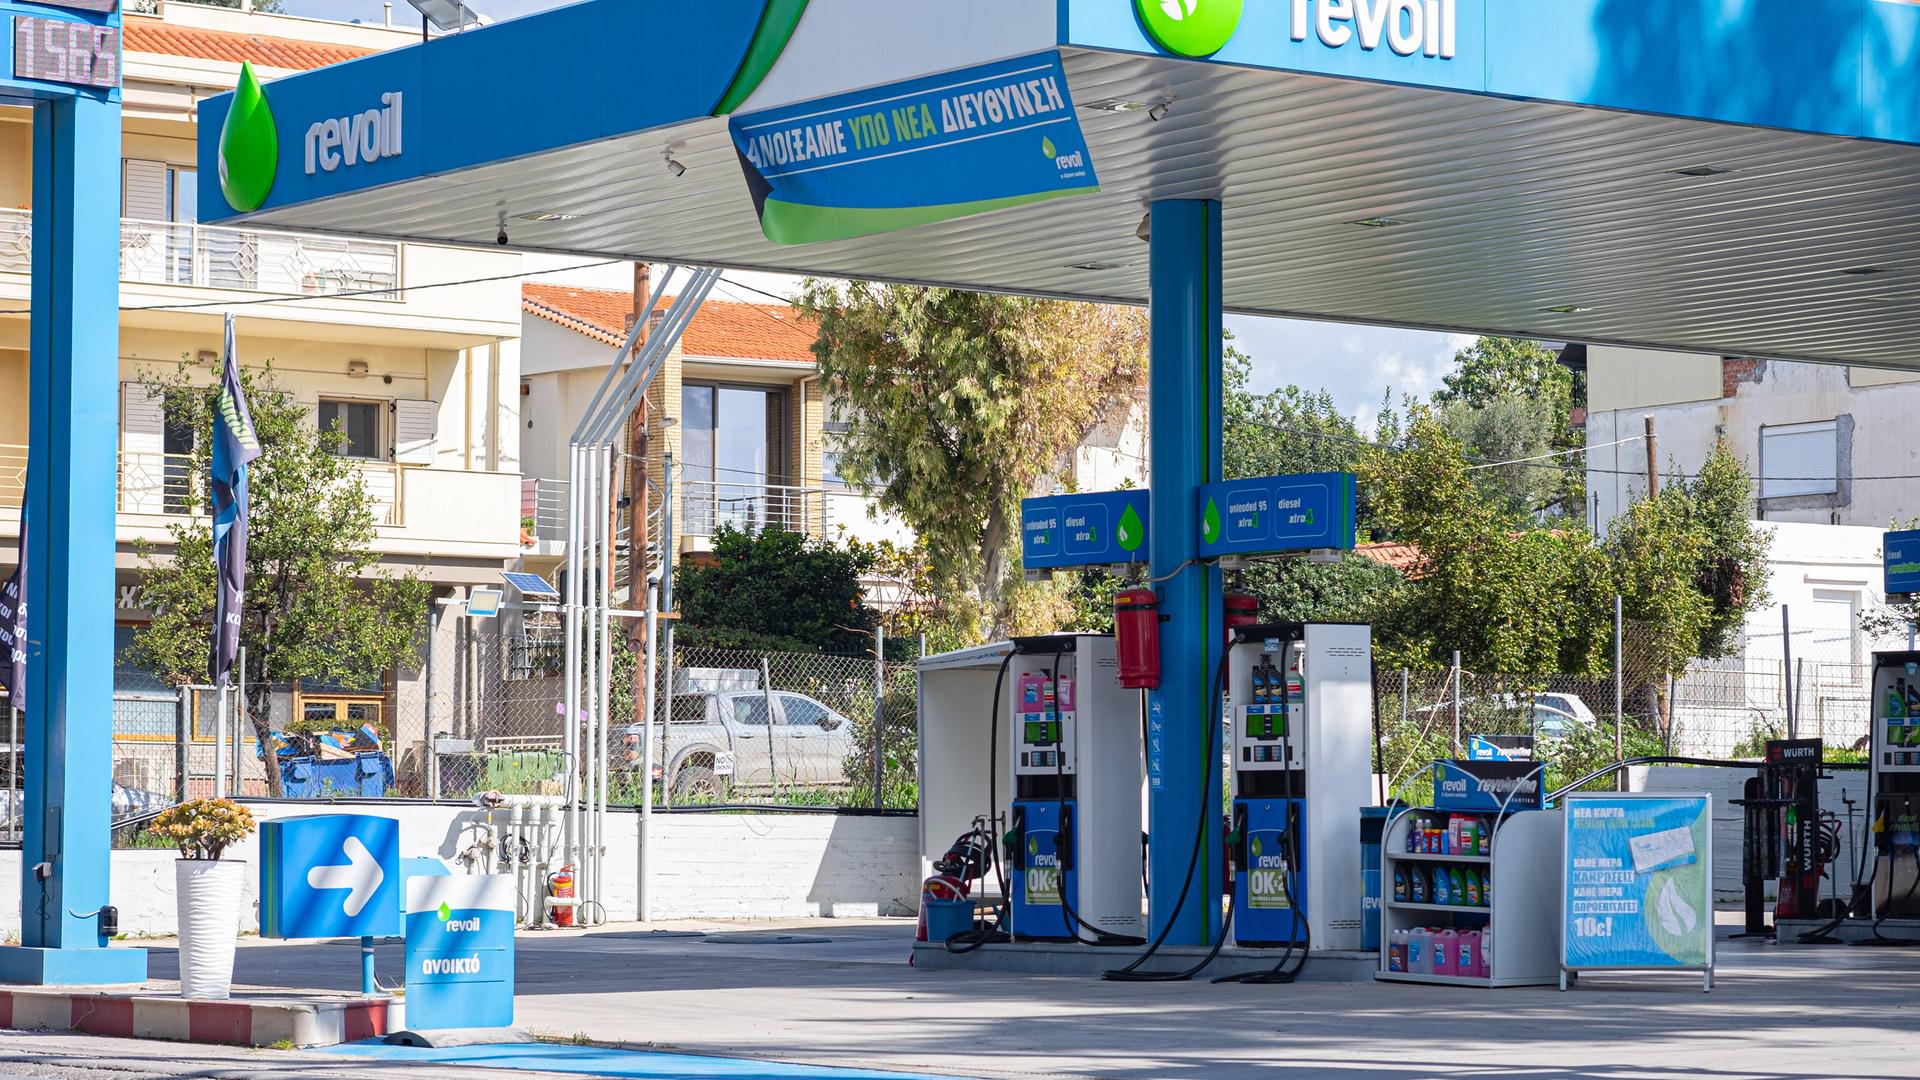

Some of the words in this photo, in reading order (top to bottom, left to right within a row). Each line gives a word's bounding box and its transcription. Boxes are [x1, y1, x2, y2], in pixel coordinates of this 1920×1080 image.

[1290, 0, 1456, 60] revoil
[848, 111, 890, 150] ΥΠΟ
[891, 103, 938, 142] ΝΕΑ
[940, 76, 1065, 134] ΔΙΕΥΘΥΝΣΗ
[304, 91, 403, 175] revoil
[1055, 150, 1083, 170] revoil
[1258, 500, 1268, 511] 95
[1278, 498, 1301, 510] diesel
[1049, 518, 1057, 529] 95
[1065, 516, 1085, 528] diesel
[1783, 747, 1815, 758] WÜRTH
[1442, 778, 1467, 792] revoil
[1574, 871, 1633, 883] ΚΛΗΡΩΣΕΙΣ
[1574, 902, 1637, 912] ΔΩΡΟΕΠΙΤΑΓΕΣ
[446, 917, 481, 932] revoil
[422, 953, 481, 975] ανοικτό
